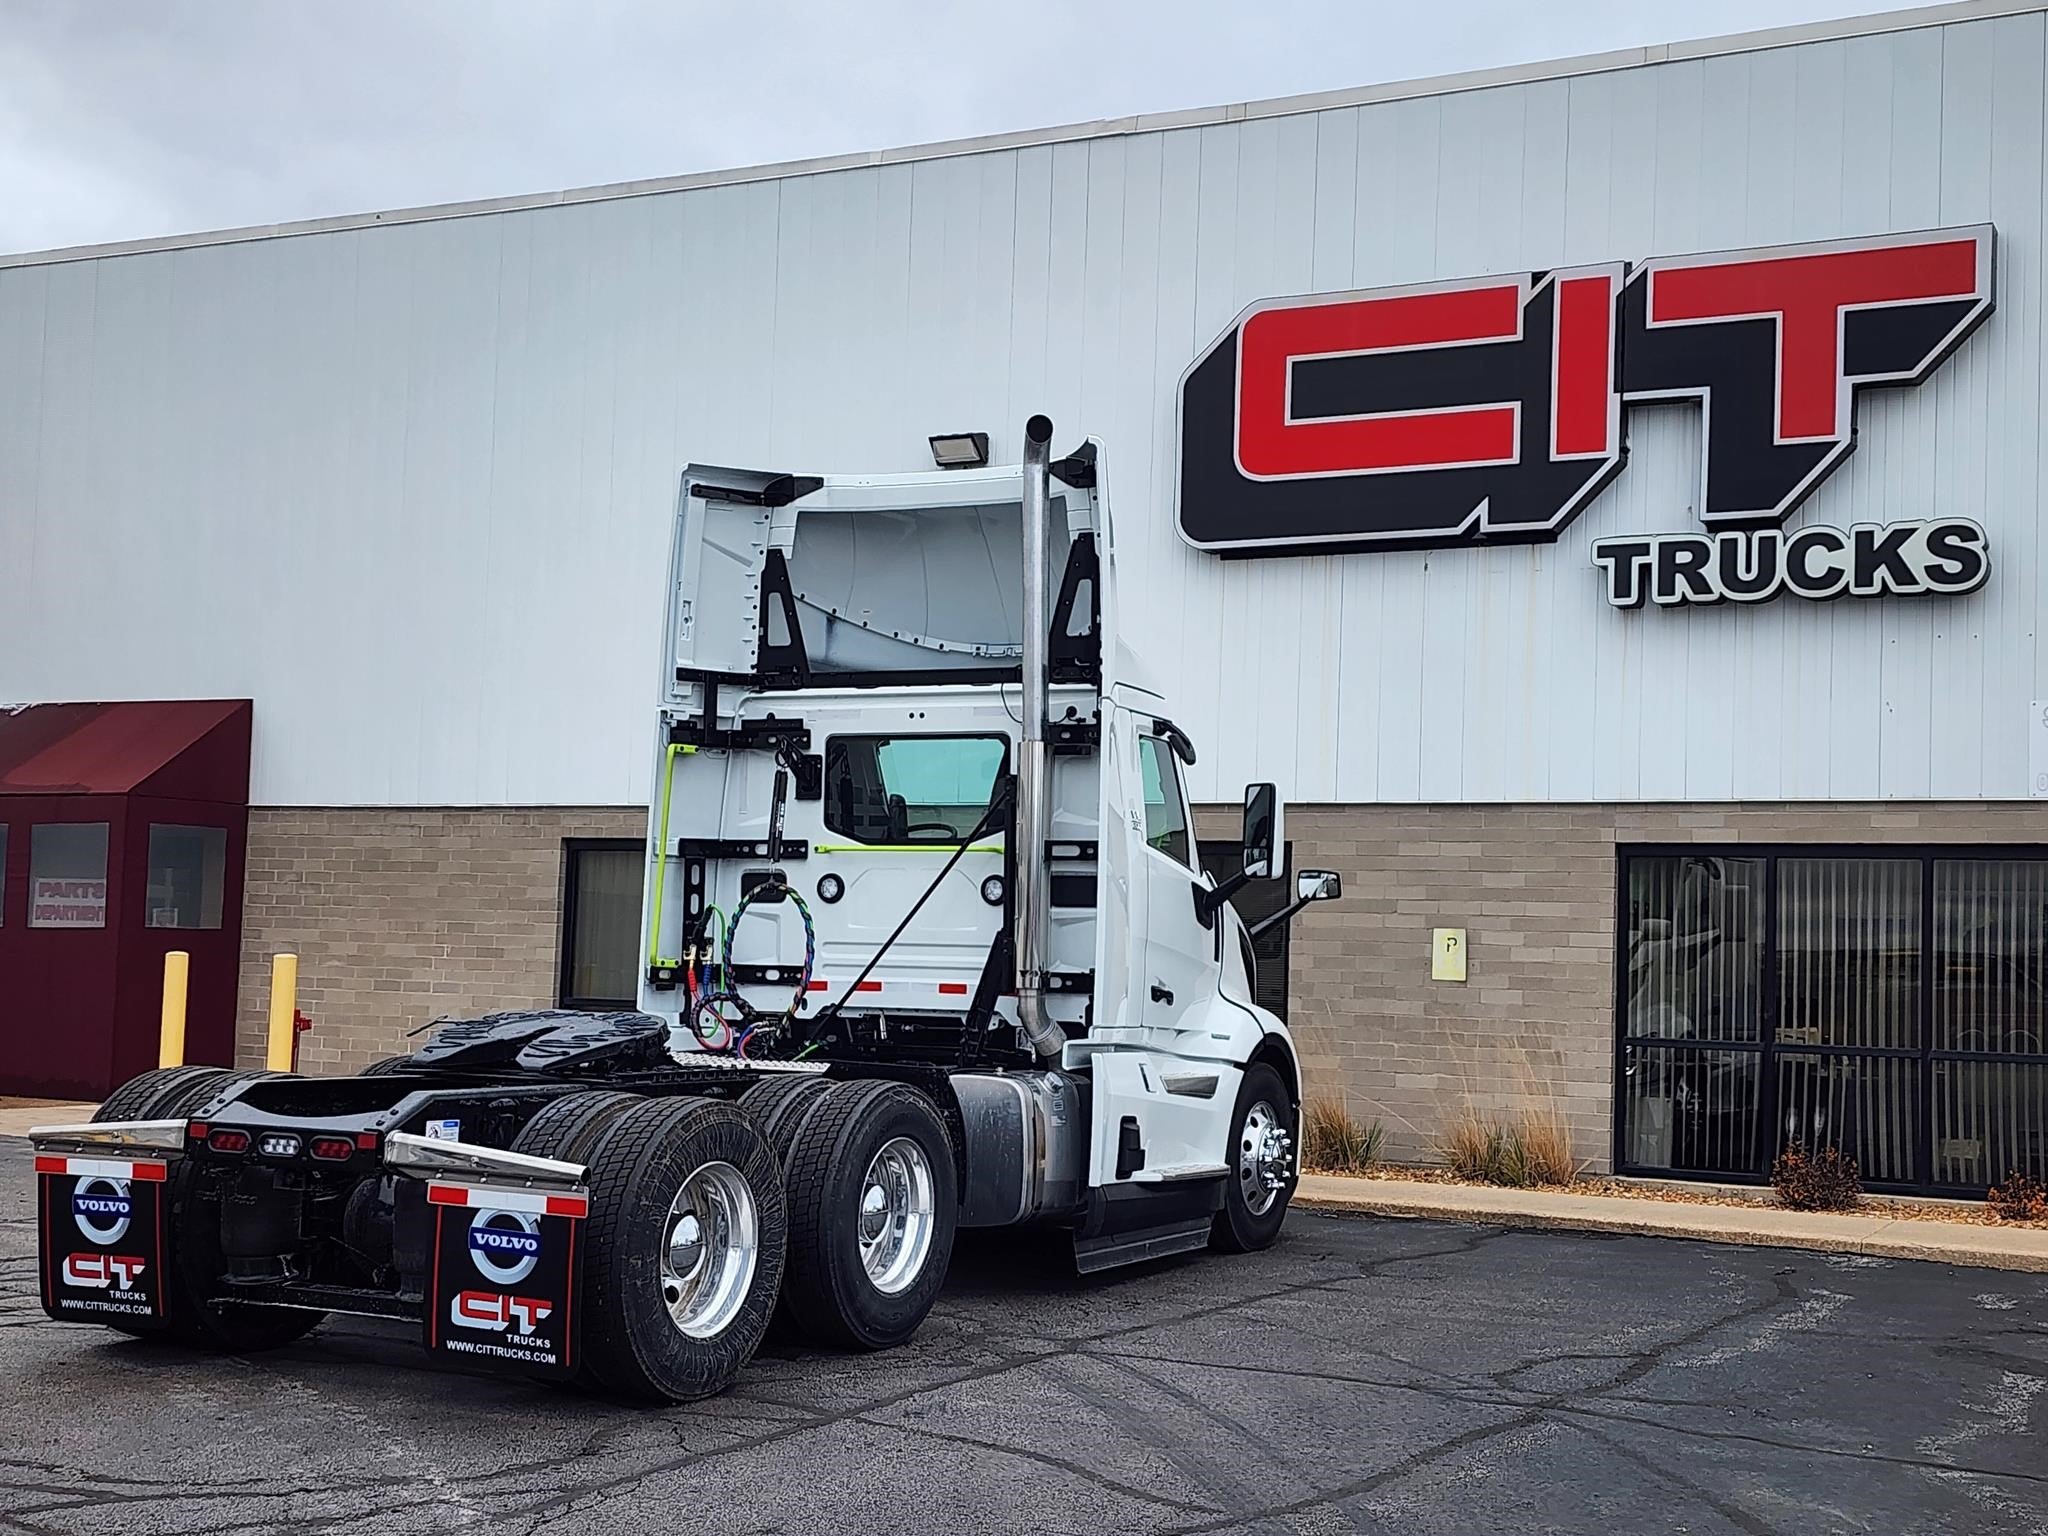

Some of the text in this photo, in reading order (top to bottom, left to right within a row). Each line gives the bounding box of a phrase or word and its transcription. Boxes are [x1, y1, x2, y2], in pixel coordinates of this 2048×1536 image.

[1180, 225, 1995, 553] CIT
[1595, 522, 1987, 602] TRUCKS
[39, 882, 104, 899] PARTS
[76, 1199, 130, 1213] VOLVO
[473, 1232, 538, 1251] VOLVO
[63, 1252, 145, 1290] CIT
[109, 1290, 147, 1301] TRUCKS
[60, 1299, 152, 1315] WWW.CITTRUCKS.COM
[451, 1290, 552, 1335] CIT
[506, 1333, 551, 1348] TRUCKS
[446, 1340, 556, 1364] WWW.CITTRUCKS.COM
